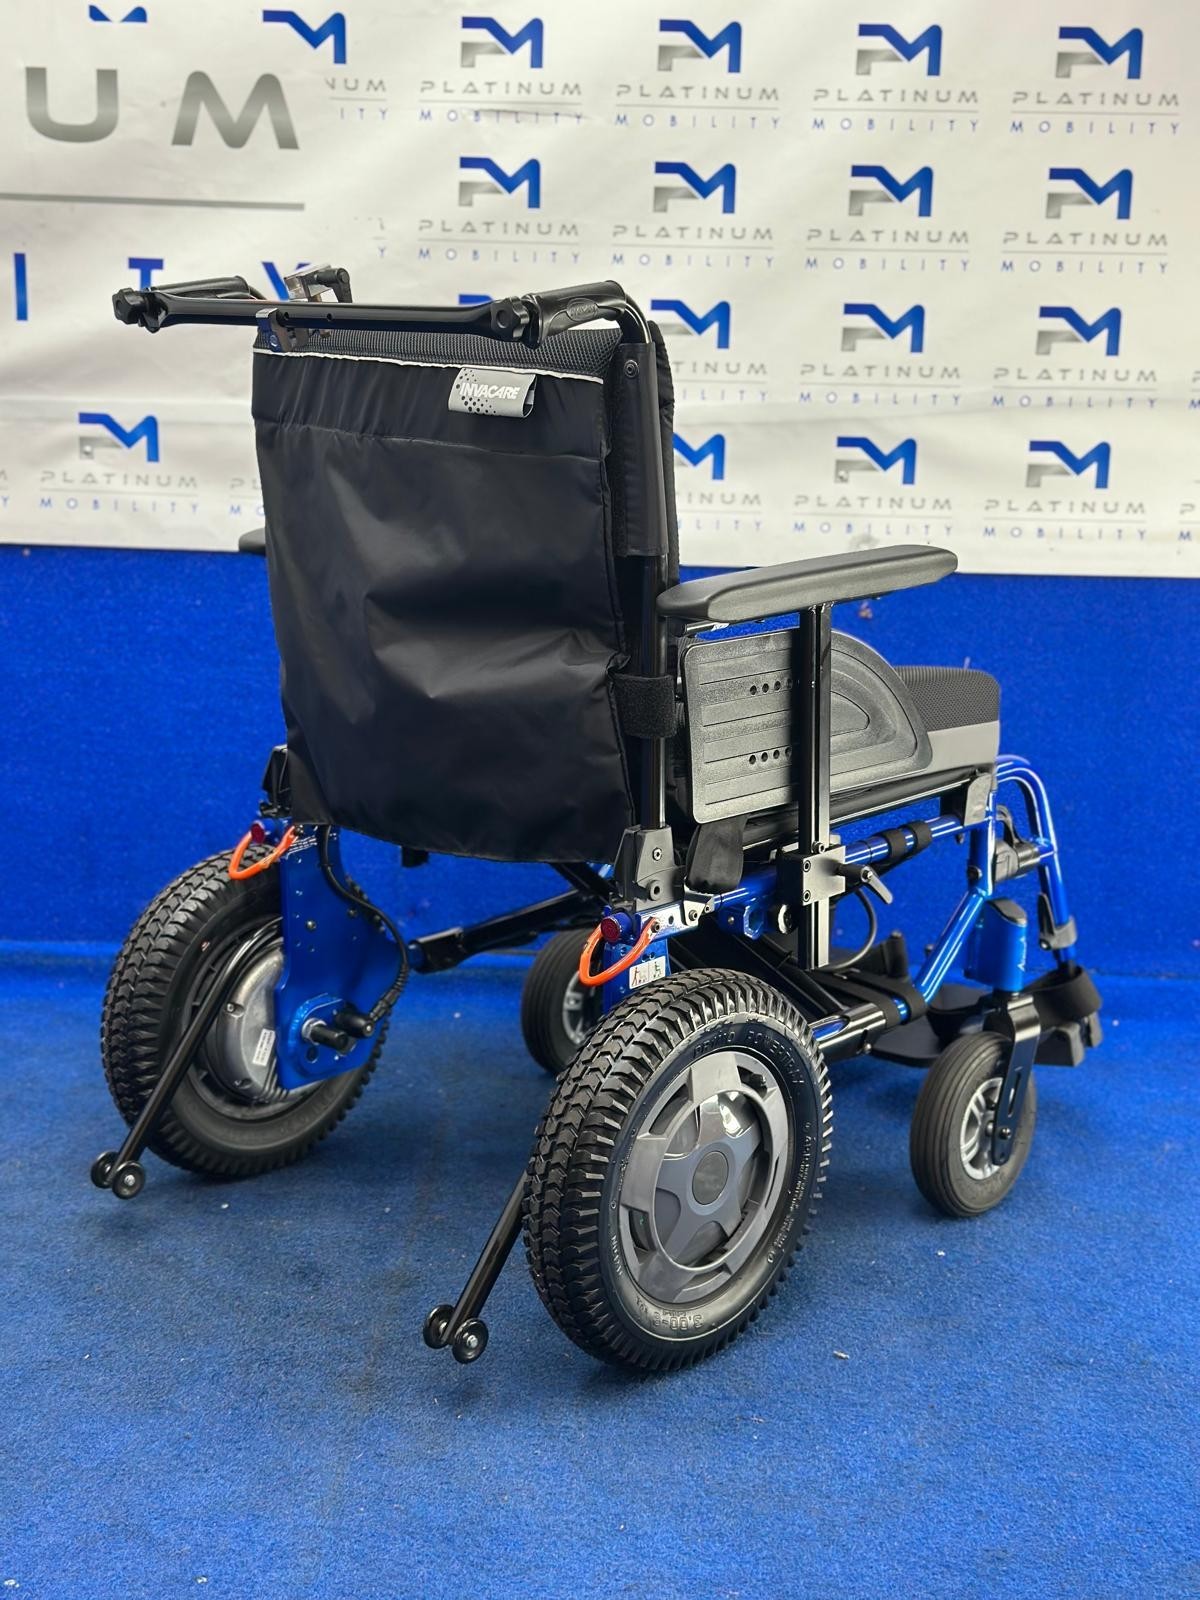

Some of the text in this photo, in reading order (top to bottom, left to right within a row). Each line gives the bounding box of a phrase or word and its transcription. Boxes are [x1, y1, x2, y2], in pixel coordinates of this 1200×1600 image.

[419, 80, 582, 97] PLATINUM
[616, 84, 779, 101] PLATINUM
[813, 89, 979, 104] PLATINUM
[1012, 91, 1180, 107] PLATINUM
[614, 113, 781, 129] MOBILITY
[811, 117, 980, 133] MOBILITY
[1009, 120, 1181, 136] MOBILITY
[418, 219, 579, 236] PLATINUM
[612, 224, 774, 241] PLATINUM
[806, 228, 969, 244] PLATINUM
[1003, 231, 1168, 247] PLATINUM
[418, 248, 580, 264] MOBILITY
[611, 253, 774, 268] MOBILITY
[804, 256, 970, 272] MOBILITY
[1001, 259, 1168, 274] MOBILITY
[800, 363, 961, 379] PLATINUM
[993, 367, 1157, 382] PLATINUM
[460, 382, 520, 400] INVACARE
[799, 391, 961, 406] MOBILITY
[992, 395, 1157, 410] MOBILITY
[672, 432, 726, 481] M
[40, 470, 198, 488] PLATINUM
[39, 497, 199, 513] MOBILITY
[793, 495, 953, 511] PLATINUM
[984, 499, 1147, 515] PLATINUM
[793, 520, 953, 536] MOBILITY
[983, 526, 1147, 541] MOBILITY
